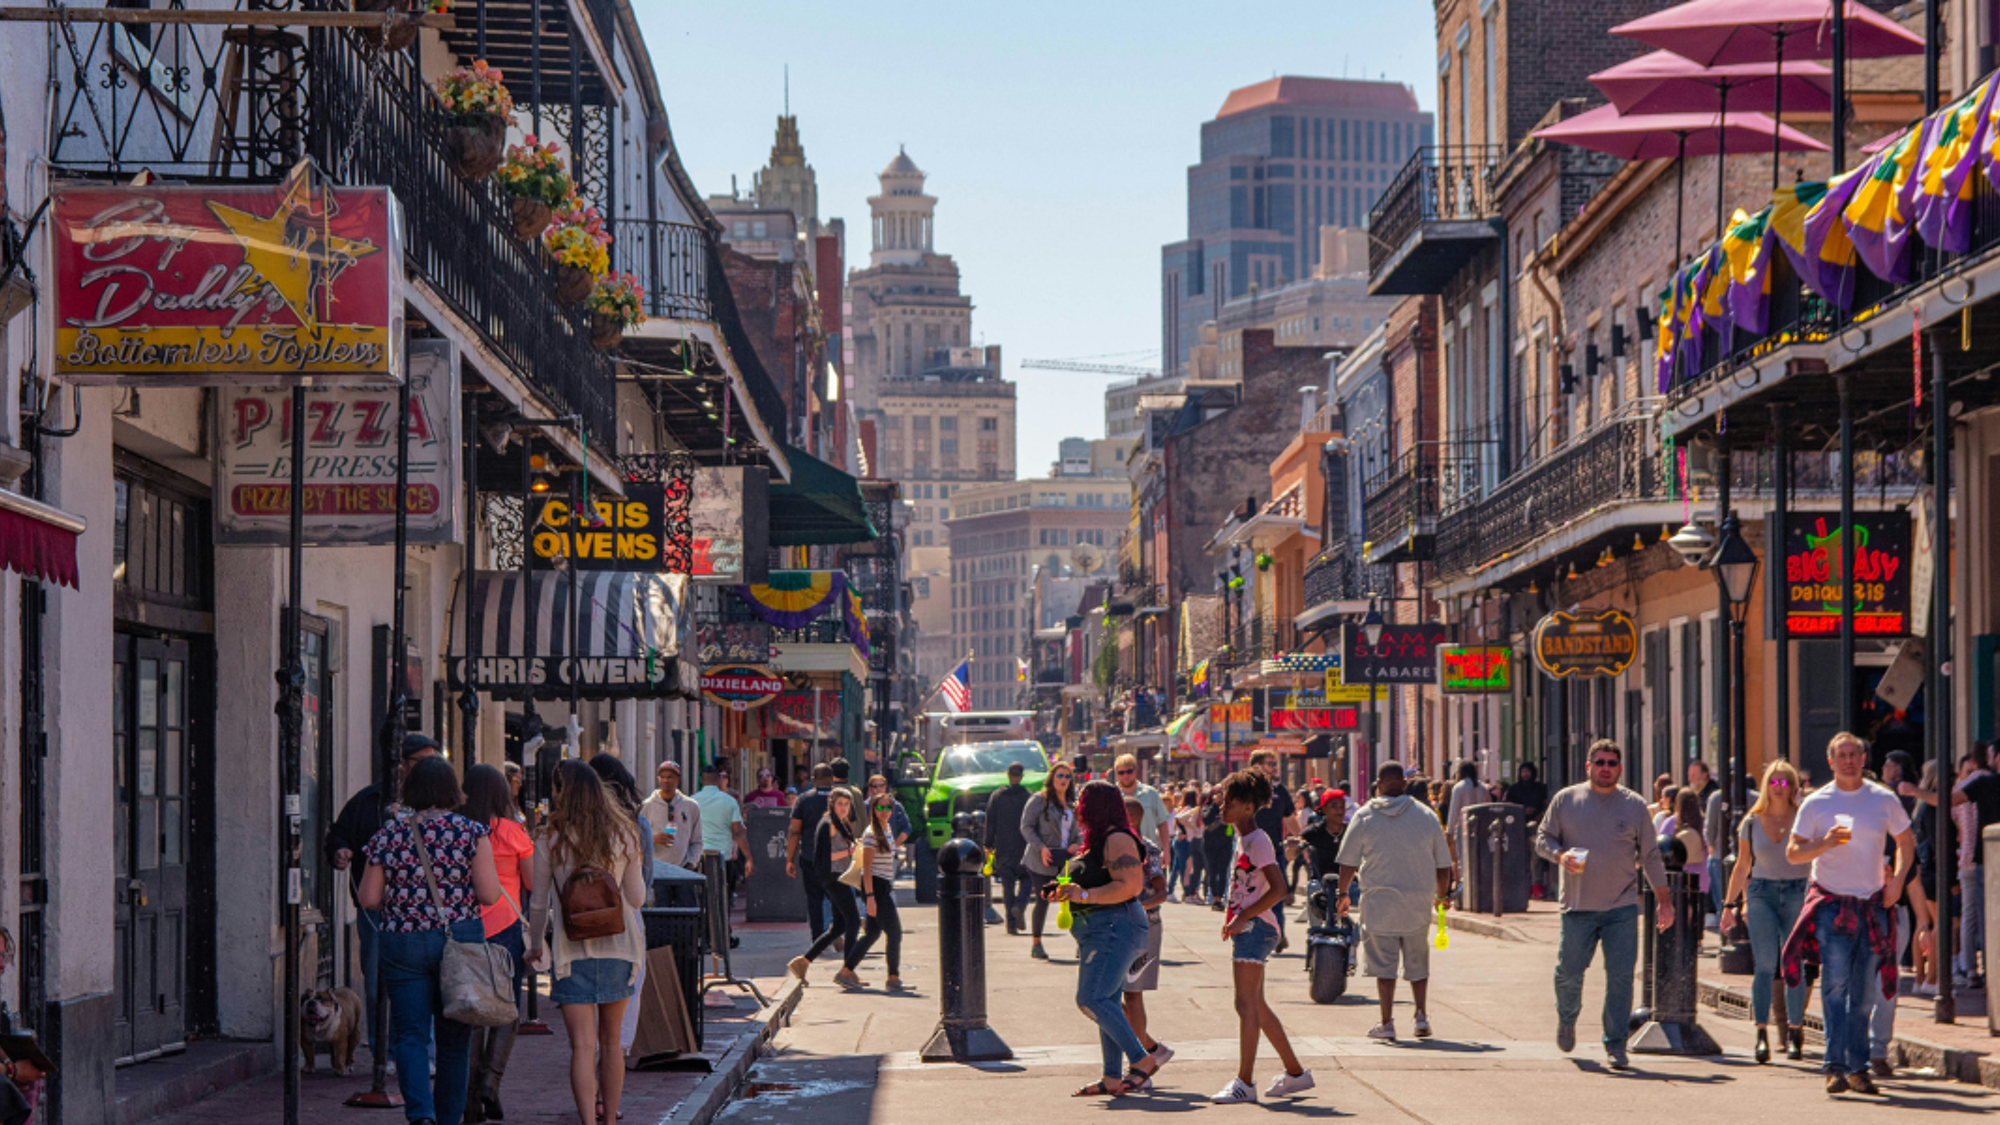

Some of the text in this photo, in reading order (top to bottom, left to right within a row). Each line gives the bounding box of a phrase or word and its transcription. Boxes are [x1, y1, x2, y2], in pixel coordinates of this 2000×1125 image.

[83, 198, 199, 271] Big
[65, 263, 288, 338] Daddy's
[67, 330, 386, 370] Bottomless Topless
[234, 396, 438, 450] PIZZA
[332, 487, 371, 511] THE
[376, 486, 432, 511] SLCE
[532, 532, 658, 560] OWENS
[1787, 547, 1830, 582] BIG
[1355, 644, 1437, 658] SUTR
[1544, 634, 1632, 655] BANDSTAND
[559, 658, 665, 684] OWENS
[700, 677, 782, 692] DIXIELAND
[1335, 709, 1357, 728] CLUB
